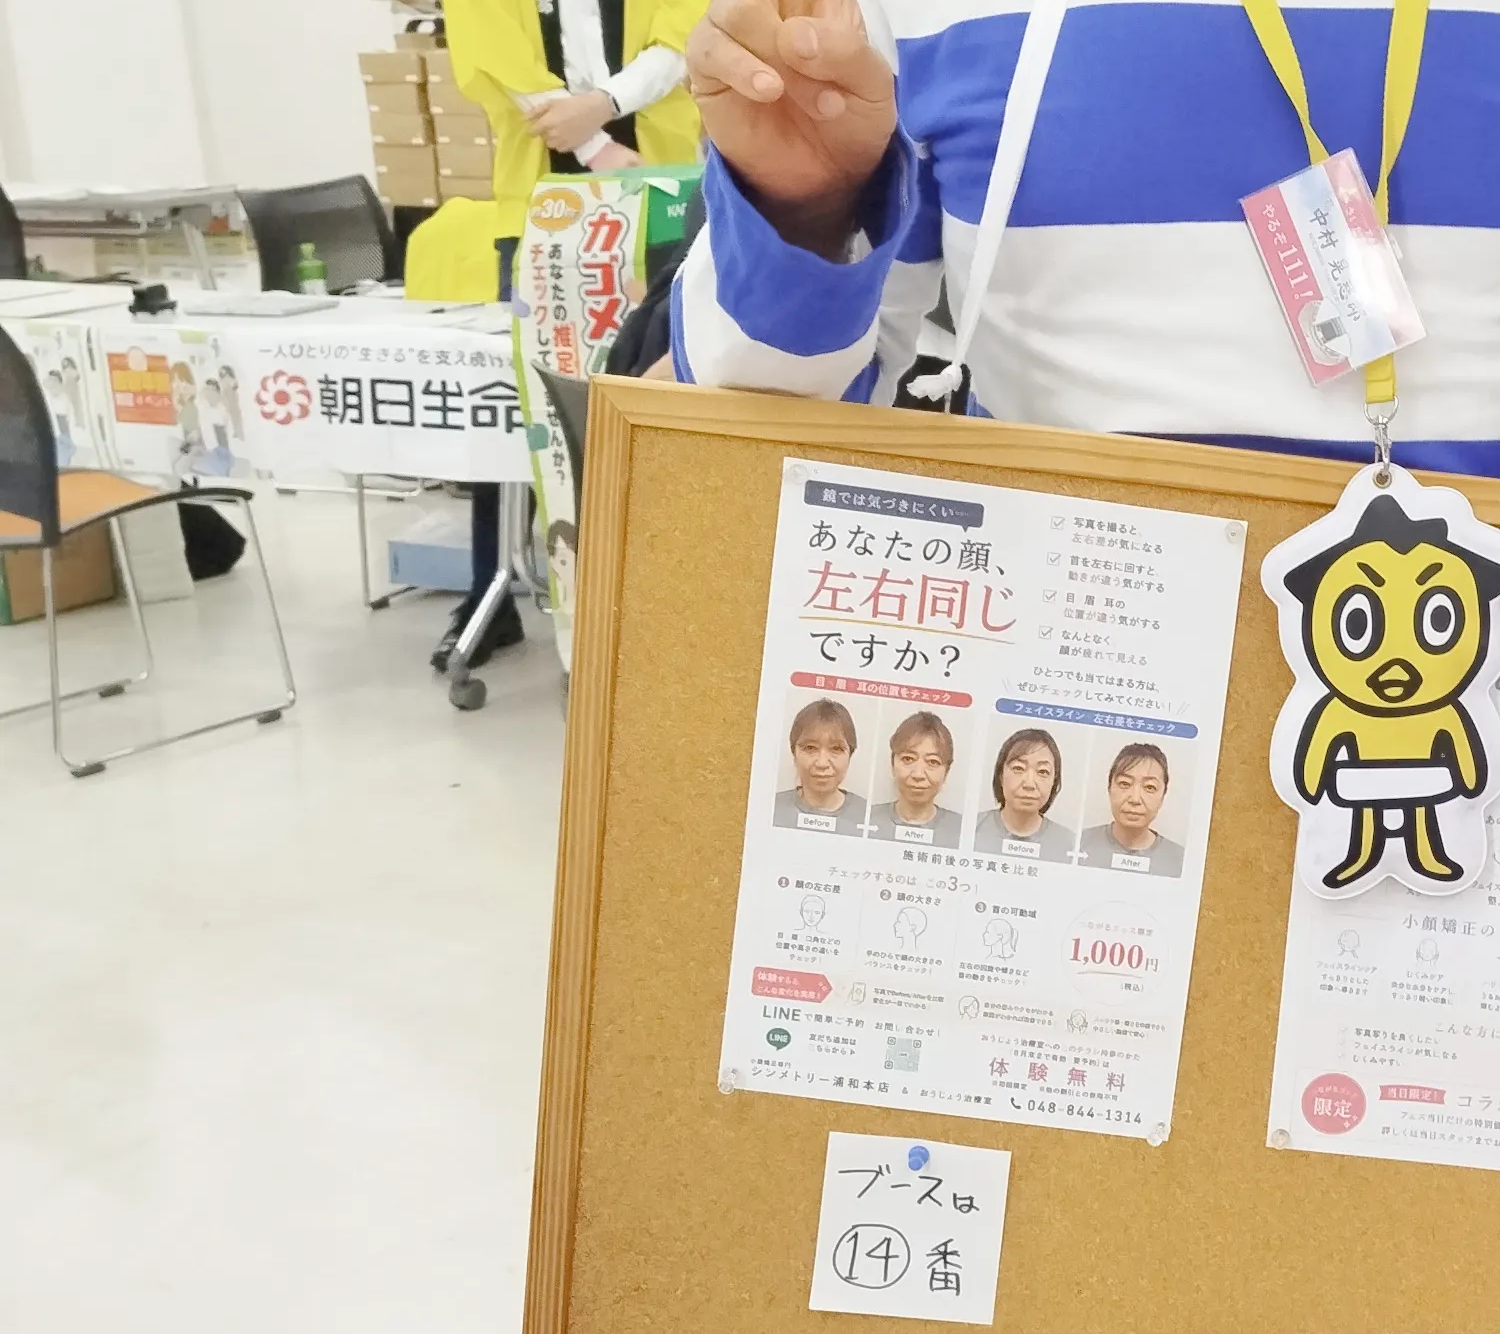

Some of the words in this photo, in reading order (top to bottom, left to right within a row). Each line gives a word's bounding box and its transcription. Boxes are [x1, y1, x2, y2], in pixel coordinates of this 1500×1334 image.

[317, 372, 527, 434] 朝日生命
[808, 519, 1006, 576] あなたの顔、
[1071, 531, 1164, 554] 左右差が気になる
[803, 560, 1017, 632] 左右同じ
[1067, 570, 1165, 593] 動きが違う気がする
[1063, 607, 1161, 630] 位置が違う気がする
[809, 631, 961, 678] ですか？
[1058, 645, 1148, 666] 顔が疲れて見える
[803, 817, 831, 829] Before
[904, 830, 925, 840] After
[1007, 843, 1035, 855] Before
[1120, 858, 1142, 868] After
[902, 849, 1039, 878] 施術前後の写真を比較
[1069, 936, 1160, 973] 1,000円
[988, 1056, 1127, 1093] 体験無料
[751, 1066, 891, 1094] シンメトリー浦和本店
[1027, 1099, 1143, 1125] 048-844-1314
[1313, 1096, 1352, 1119] 限定
[837, 1163, 981, 1214] ブースは
